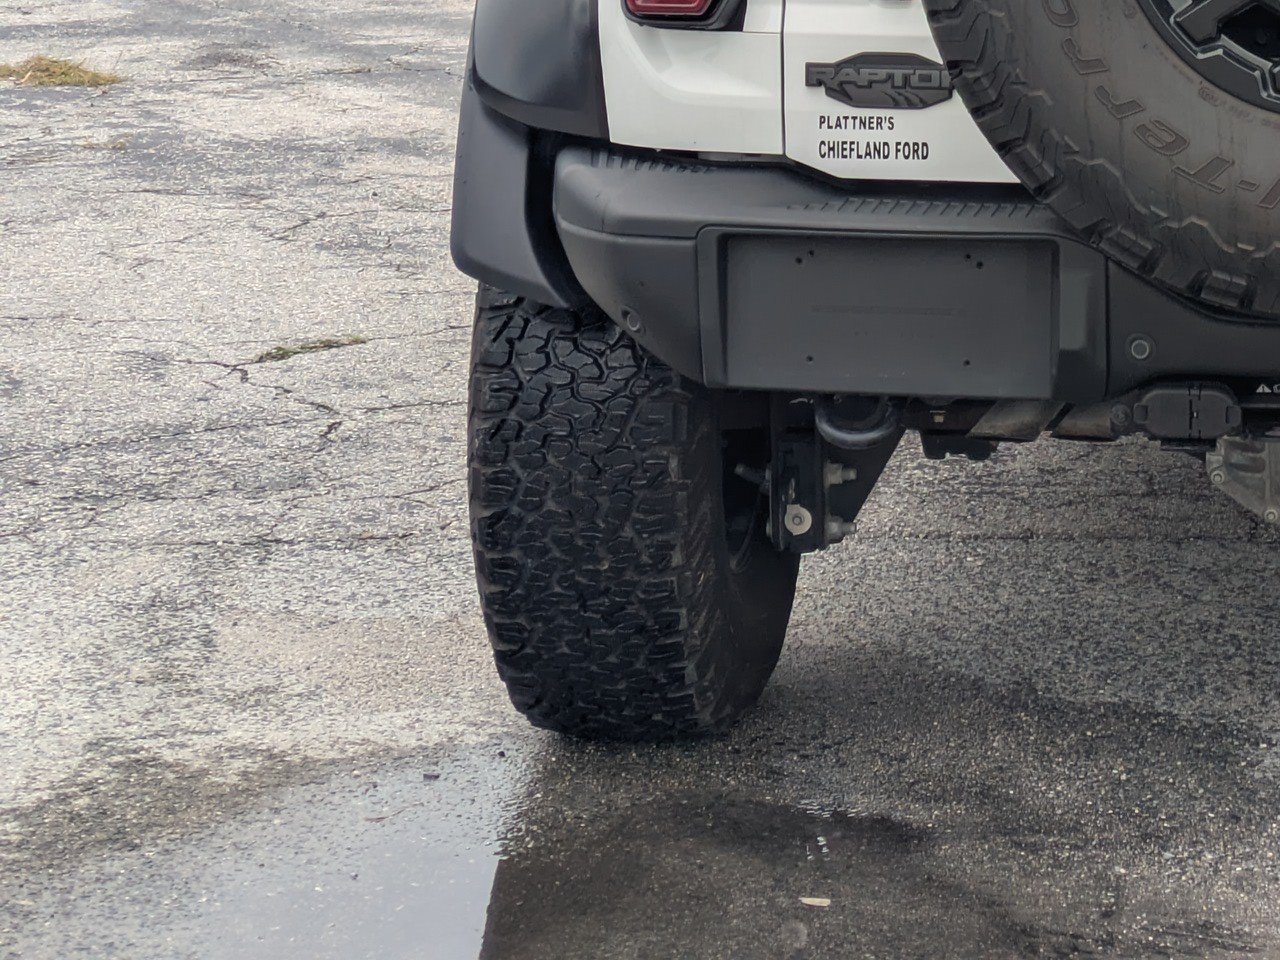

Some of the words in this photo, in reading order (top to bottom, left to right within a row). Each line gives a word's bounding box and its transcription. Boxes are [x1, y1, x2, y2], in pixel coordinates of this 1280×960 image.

[818, 115, 895, 131] PLATTNER'S
[818, 140, 890, 159] CHIEFLAND
[895, 141, 929, 160] FORD
